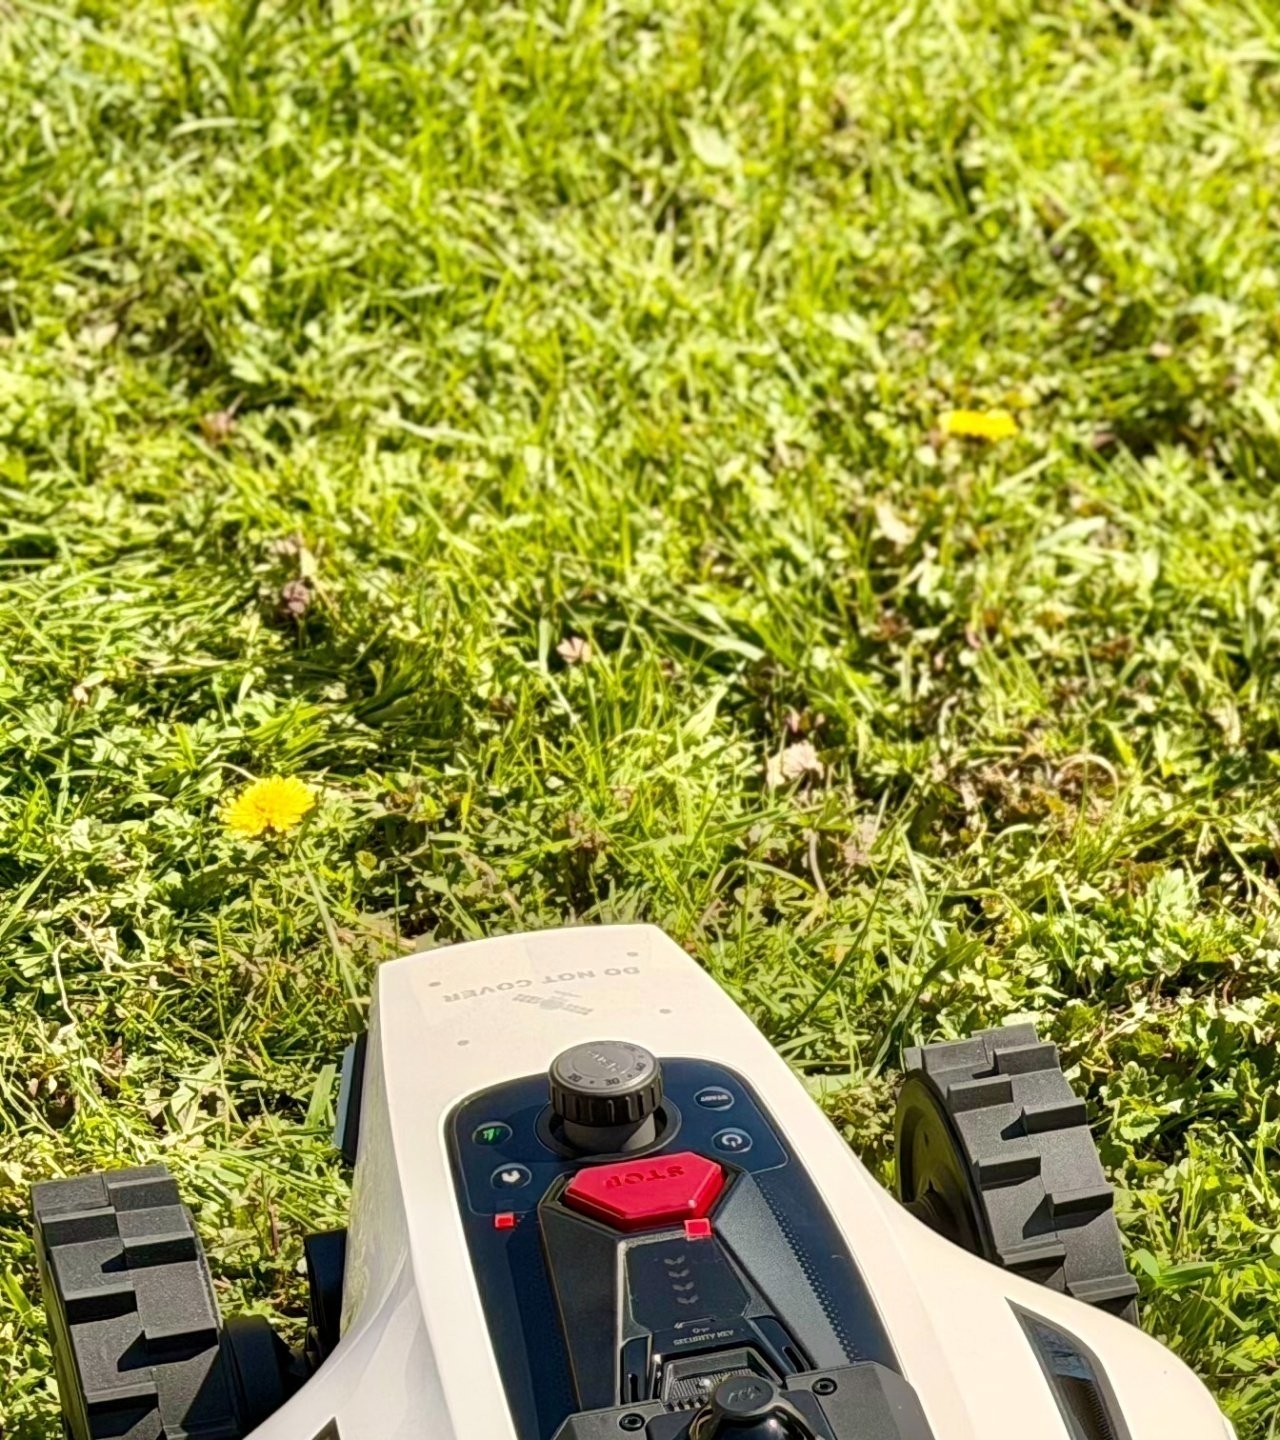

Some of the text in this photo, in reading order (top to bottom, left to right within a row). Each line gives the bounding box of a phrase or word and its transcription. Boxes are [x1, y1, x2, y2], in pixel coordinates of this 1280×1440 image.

[443, 966, 640, 1002] DO NOT COVER
[605, 1165, 685, 1188] STOP
